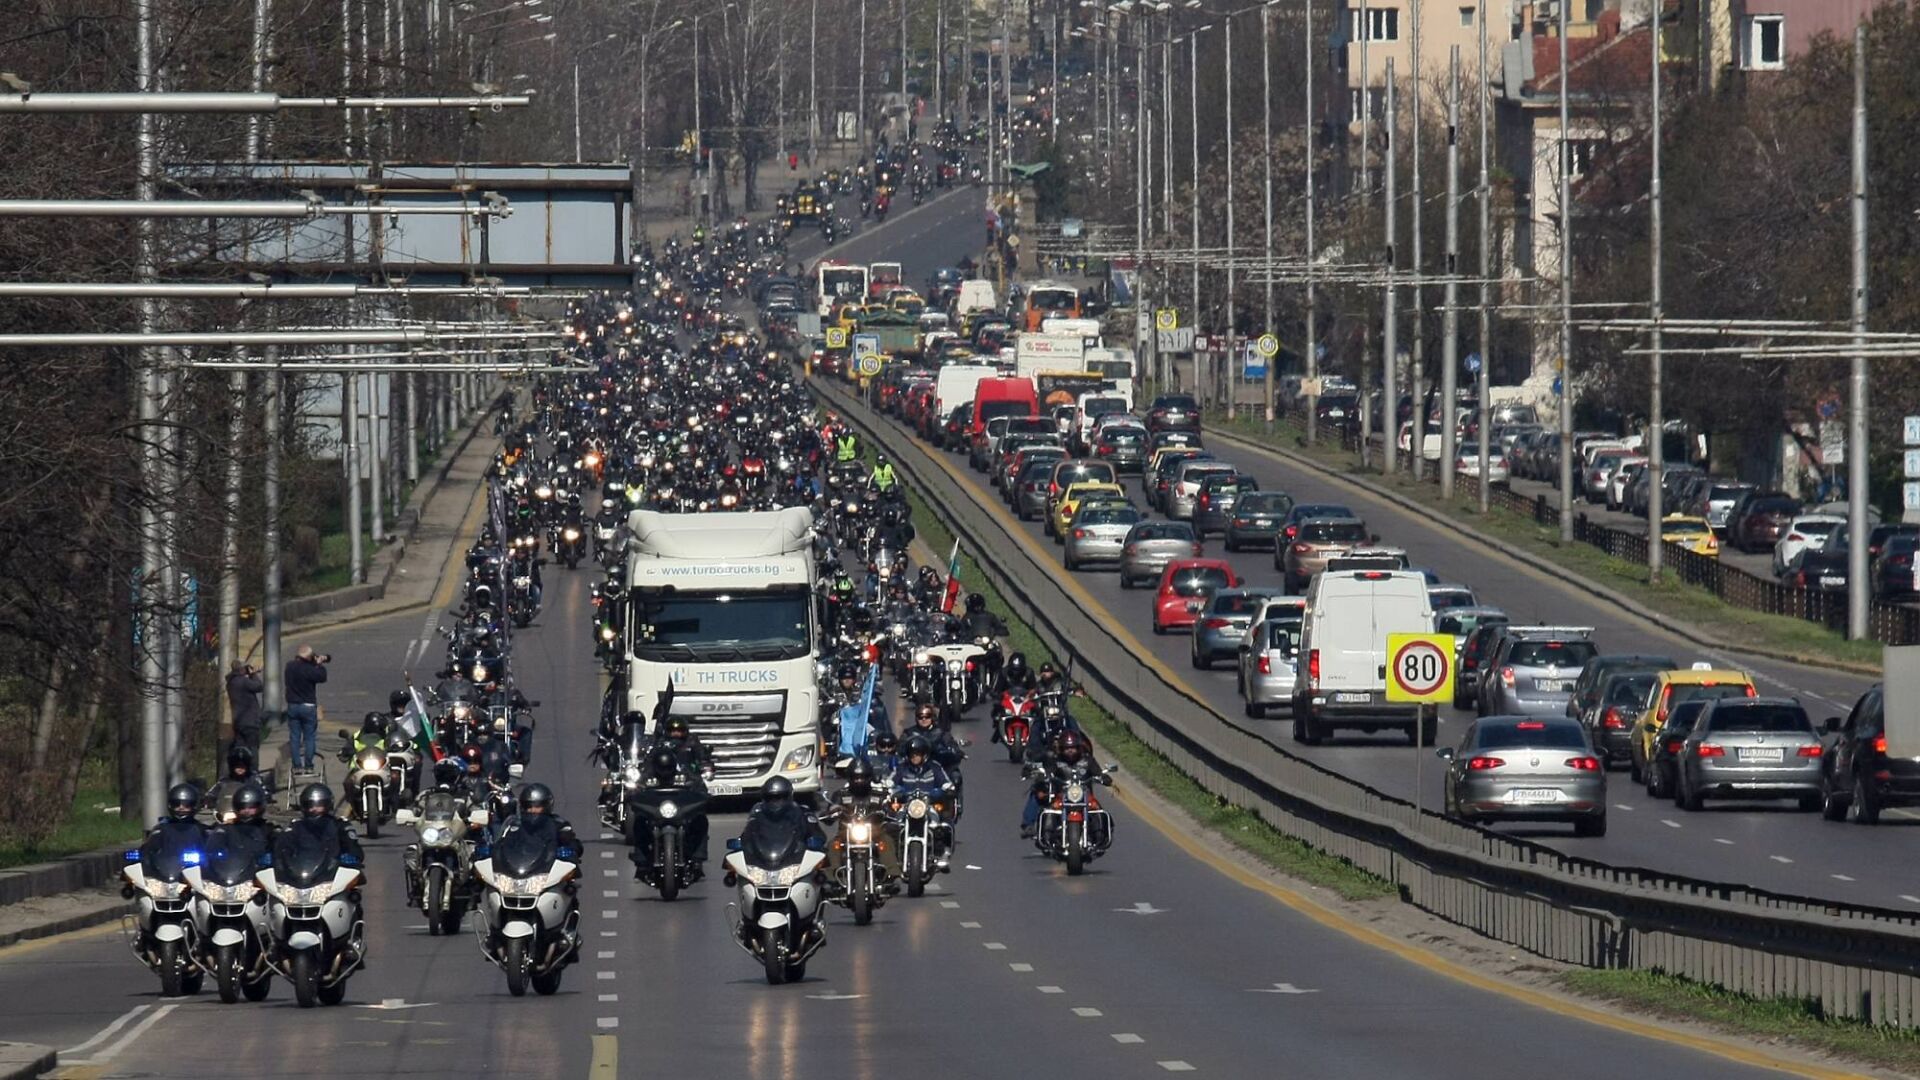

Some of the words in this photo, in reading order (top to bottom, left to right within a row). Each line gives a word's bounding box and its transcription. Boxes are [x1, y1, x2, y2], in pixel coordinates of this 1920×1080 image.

[1405, 654, 1436, 682] 80
[696, 671, 715, 684] TH
[719, 670, 778, 683] TRUCKS
[702, 703, 744, 712] DAF
